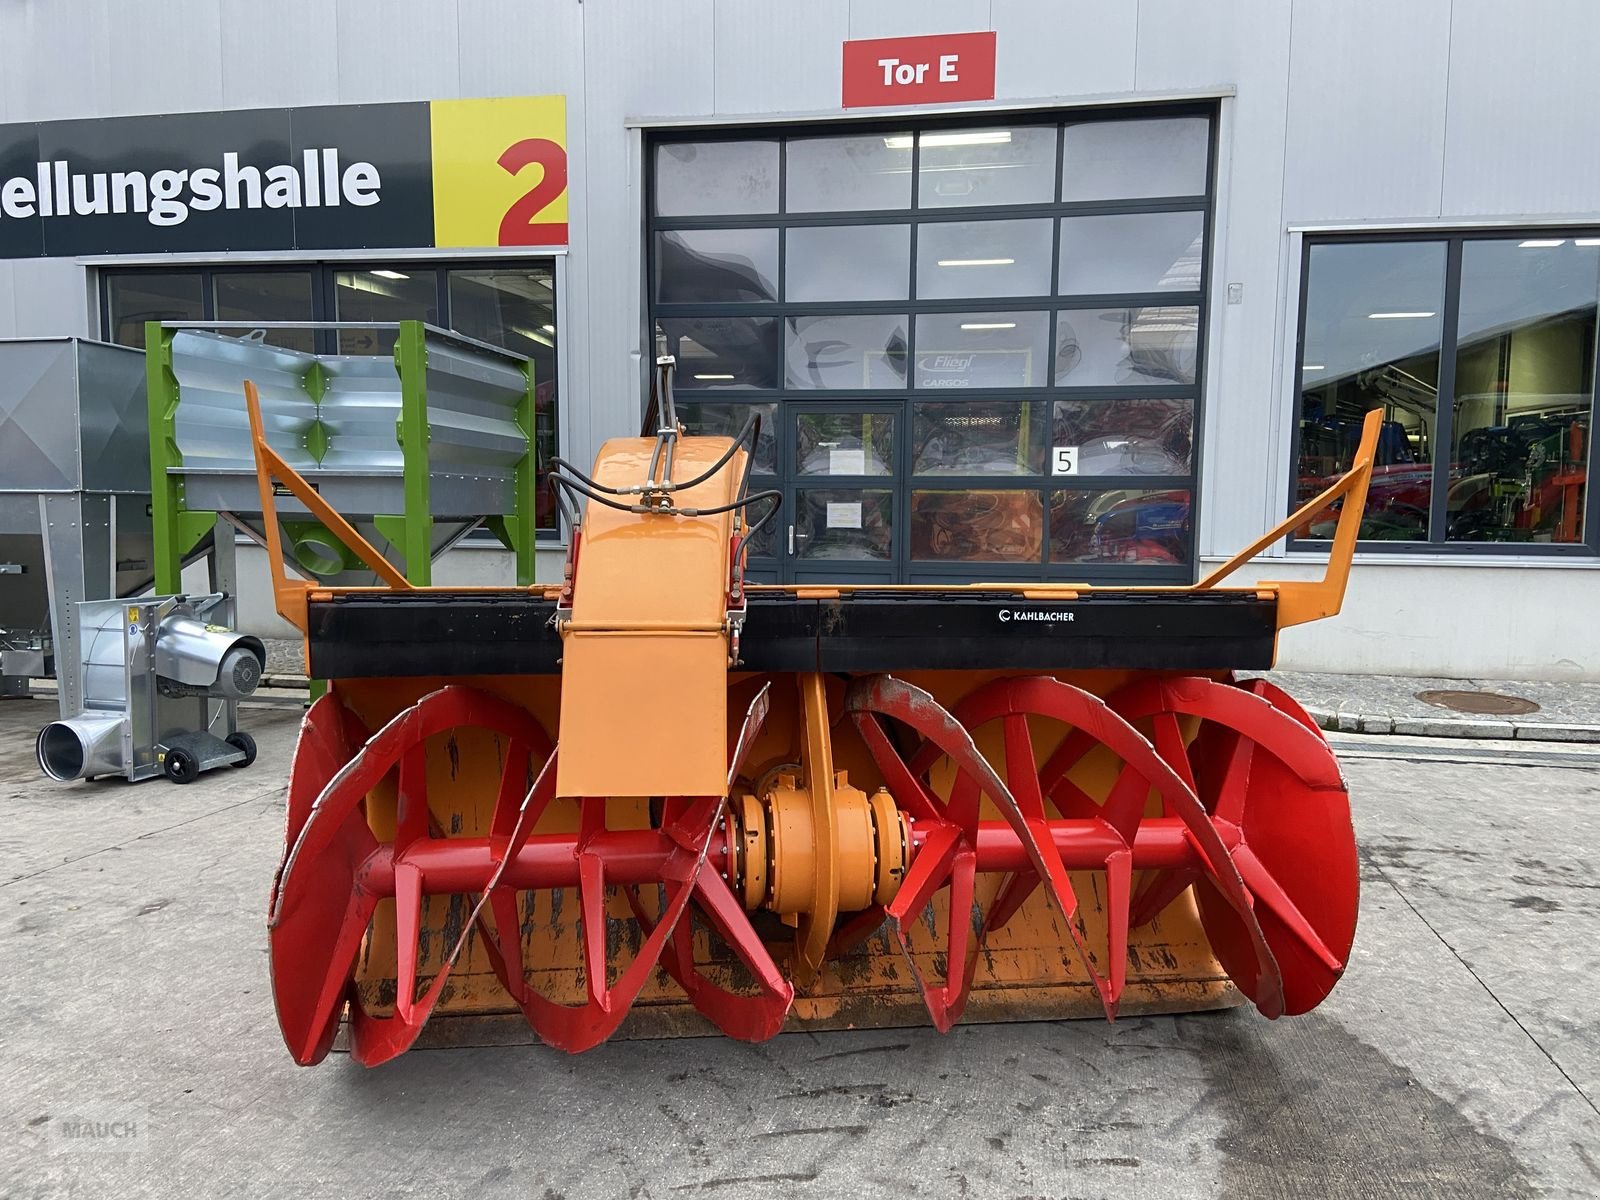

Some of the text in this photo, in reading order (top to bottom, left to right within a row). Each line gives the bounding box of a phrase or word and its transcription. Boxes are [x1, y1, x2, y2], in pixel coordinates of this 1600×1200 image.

[878, 55, 959, 86] Tor E
[0, 138, 568, 247] ellungshalle 2
[1057, 451, 1072, 472] 5
[1013, 611, 1075, 621] KAHLBACHER
